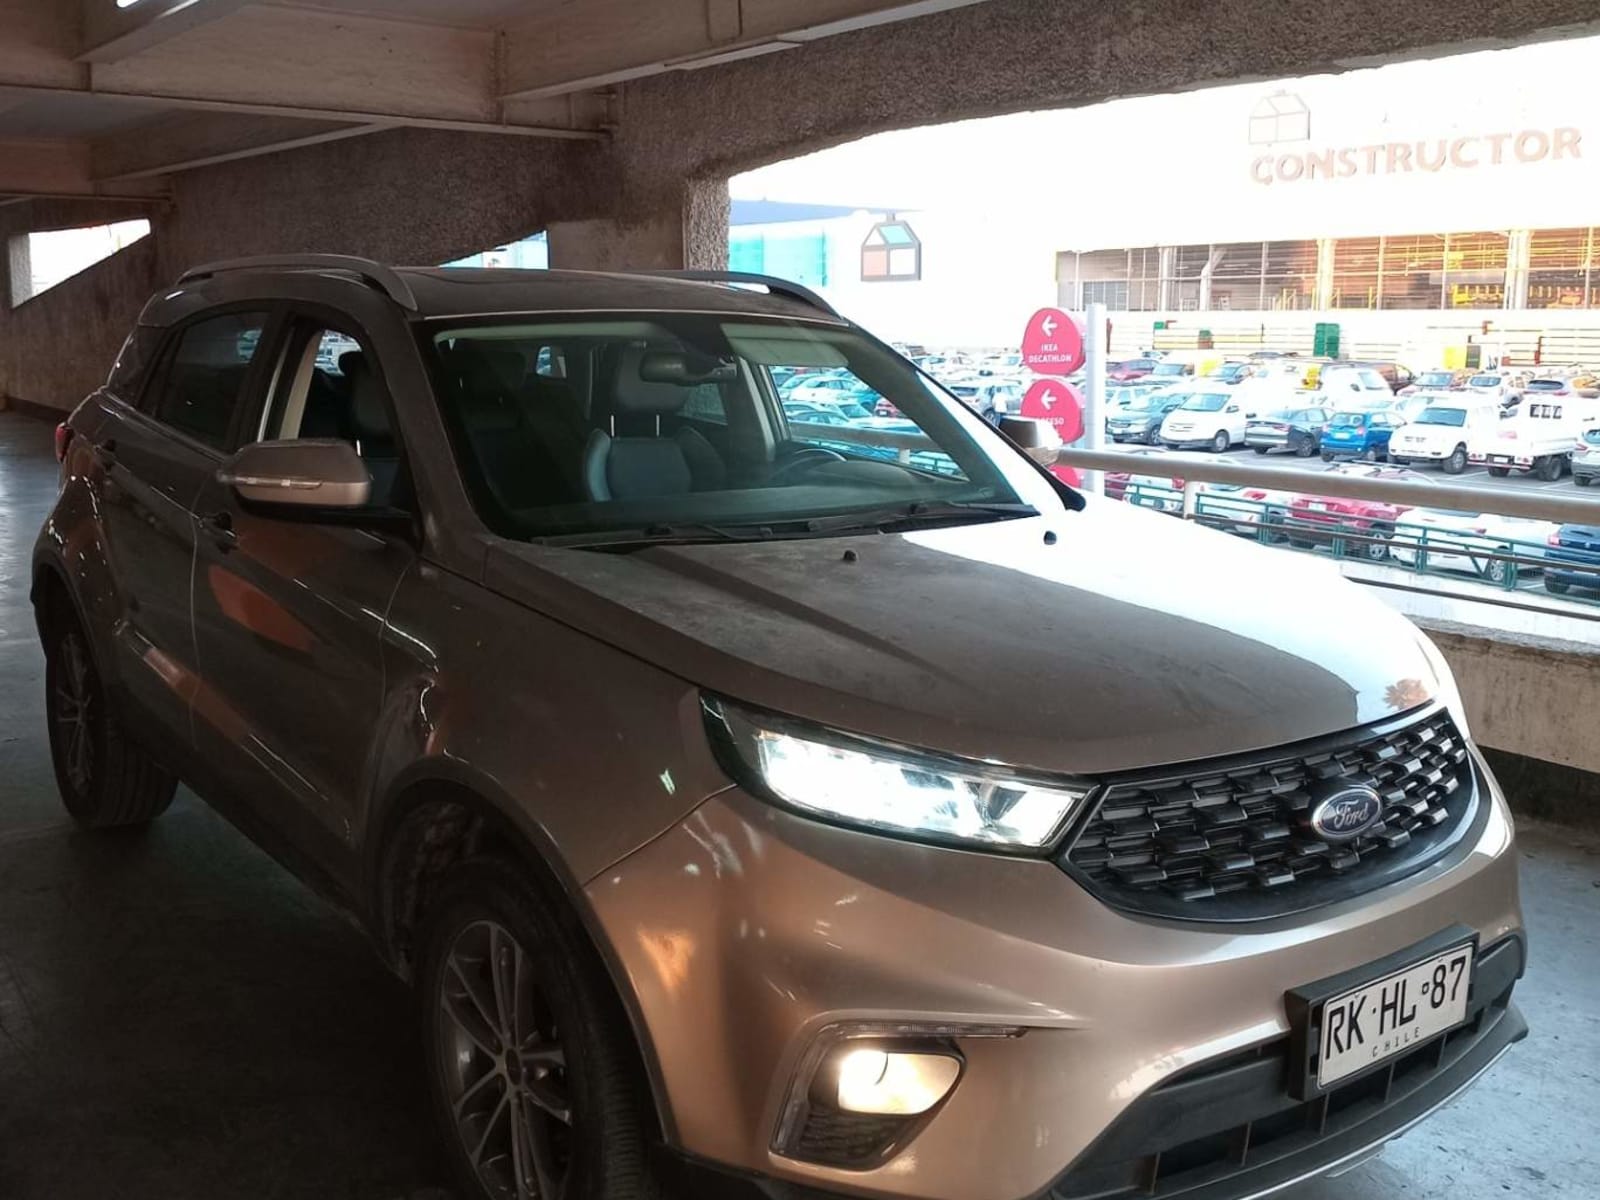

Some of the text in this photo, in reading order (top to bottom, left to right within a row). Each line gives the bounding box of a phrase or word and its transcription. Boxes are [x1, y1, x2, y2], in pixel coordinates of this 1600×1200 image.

[1250, 127, 1583, 185] CONSTRUCTOR
[1028, 353, 1072, 363] DECATHLON
[1041, 343, 1058, 352] IKEA
[1333, 799, 1369, 829] Ford
[1372, 1026, 1420, 1057] CHILE
